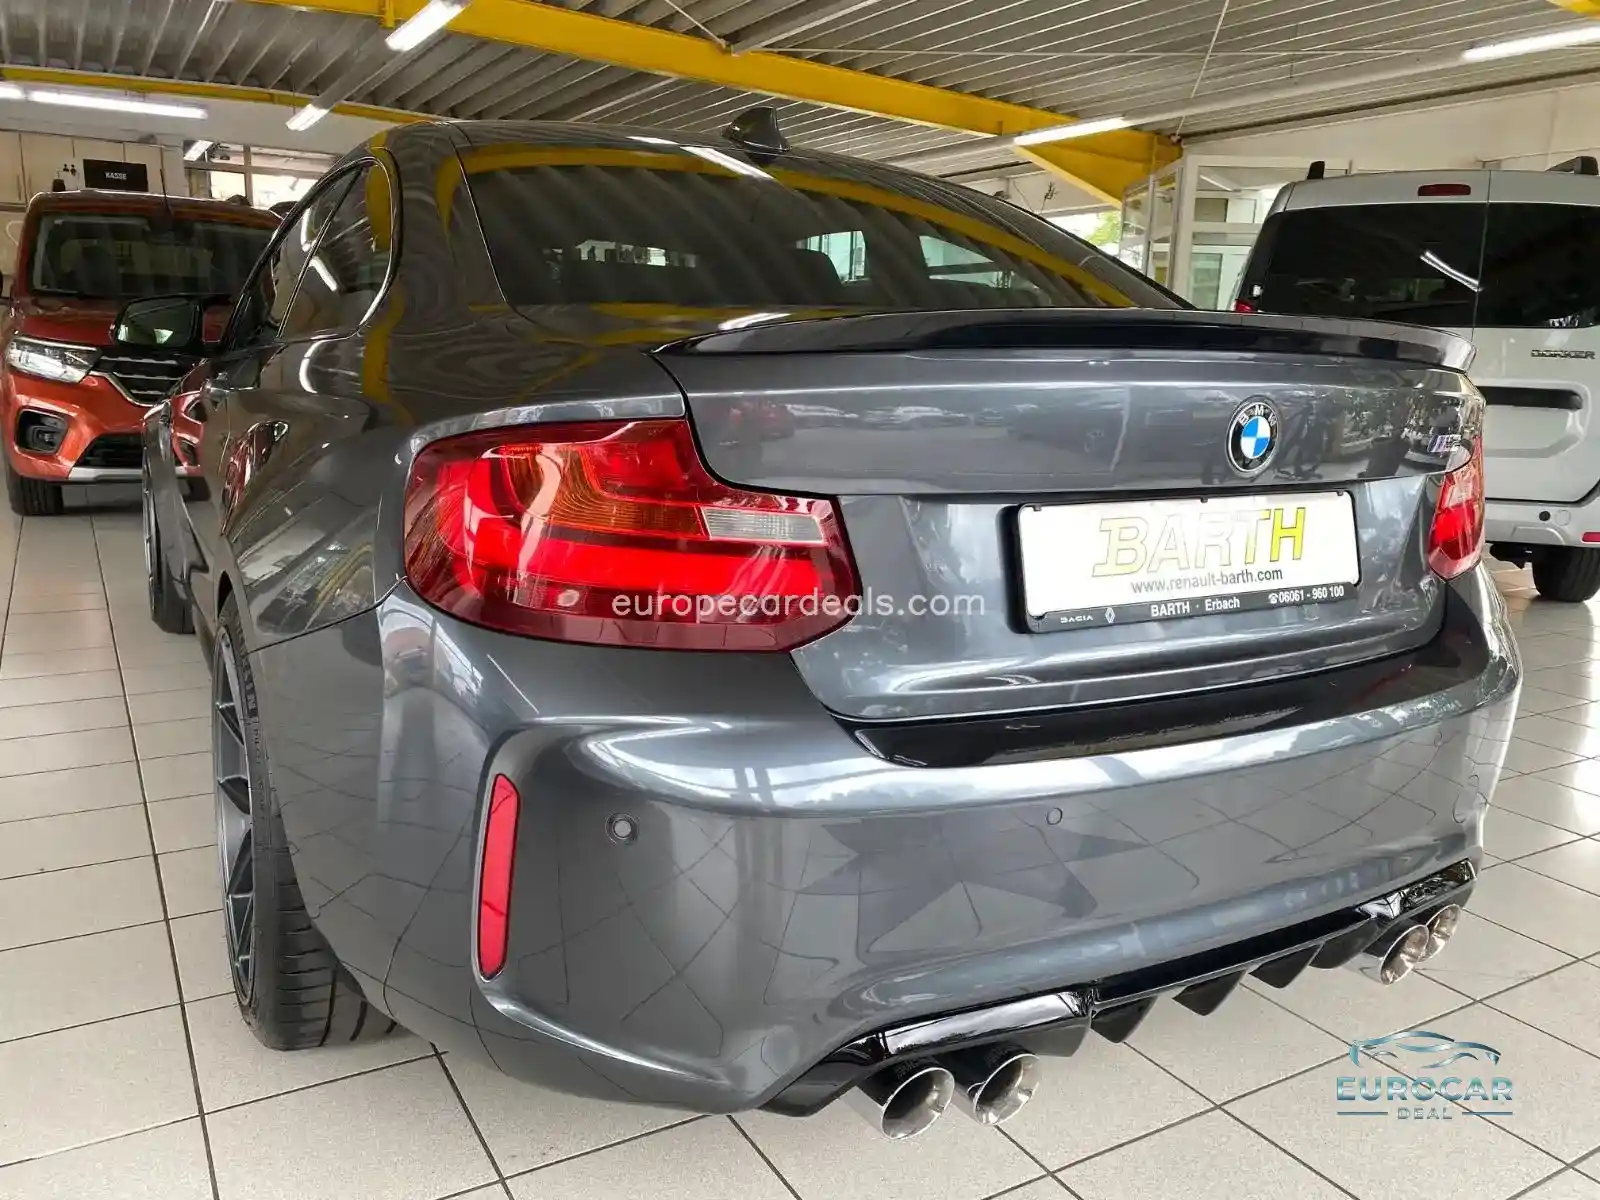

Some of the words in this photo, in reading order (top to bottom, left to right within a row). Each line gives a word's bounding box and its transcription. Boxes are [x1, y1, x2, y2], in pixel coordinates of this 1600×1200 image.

[1238, 404, 1277, 426] BMW
[1092, 507, 1306, 578] BARTH
[1131, 568, 1283, 594] www.renault-barth.com
[1150, 601, 1190, 617] BARTH
[1204, 597, 1240, 611] Erbach
[1278, 591, 1304, 603] 06061
[1312, 588, 1328, 600] 960
[1329, 585, 1344, 597] 100
